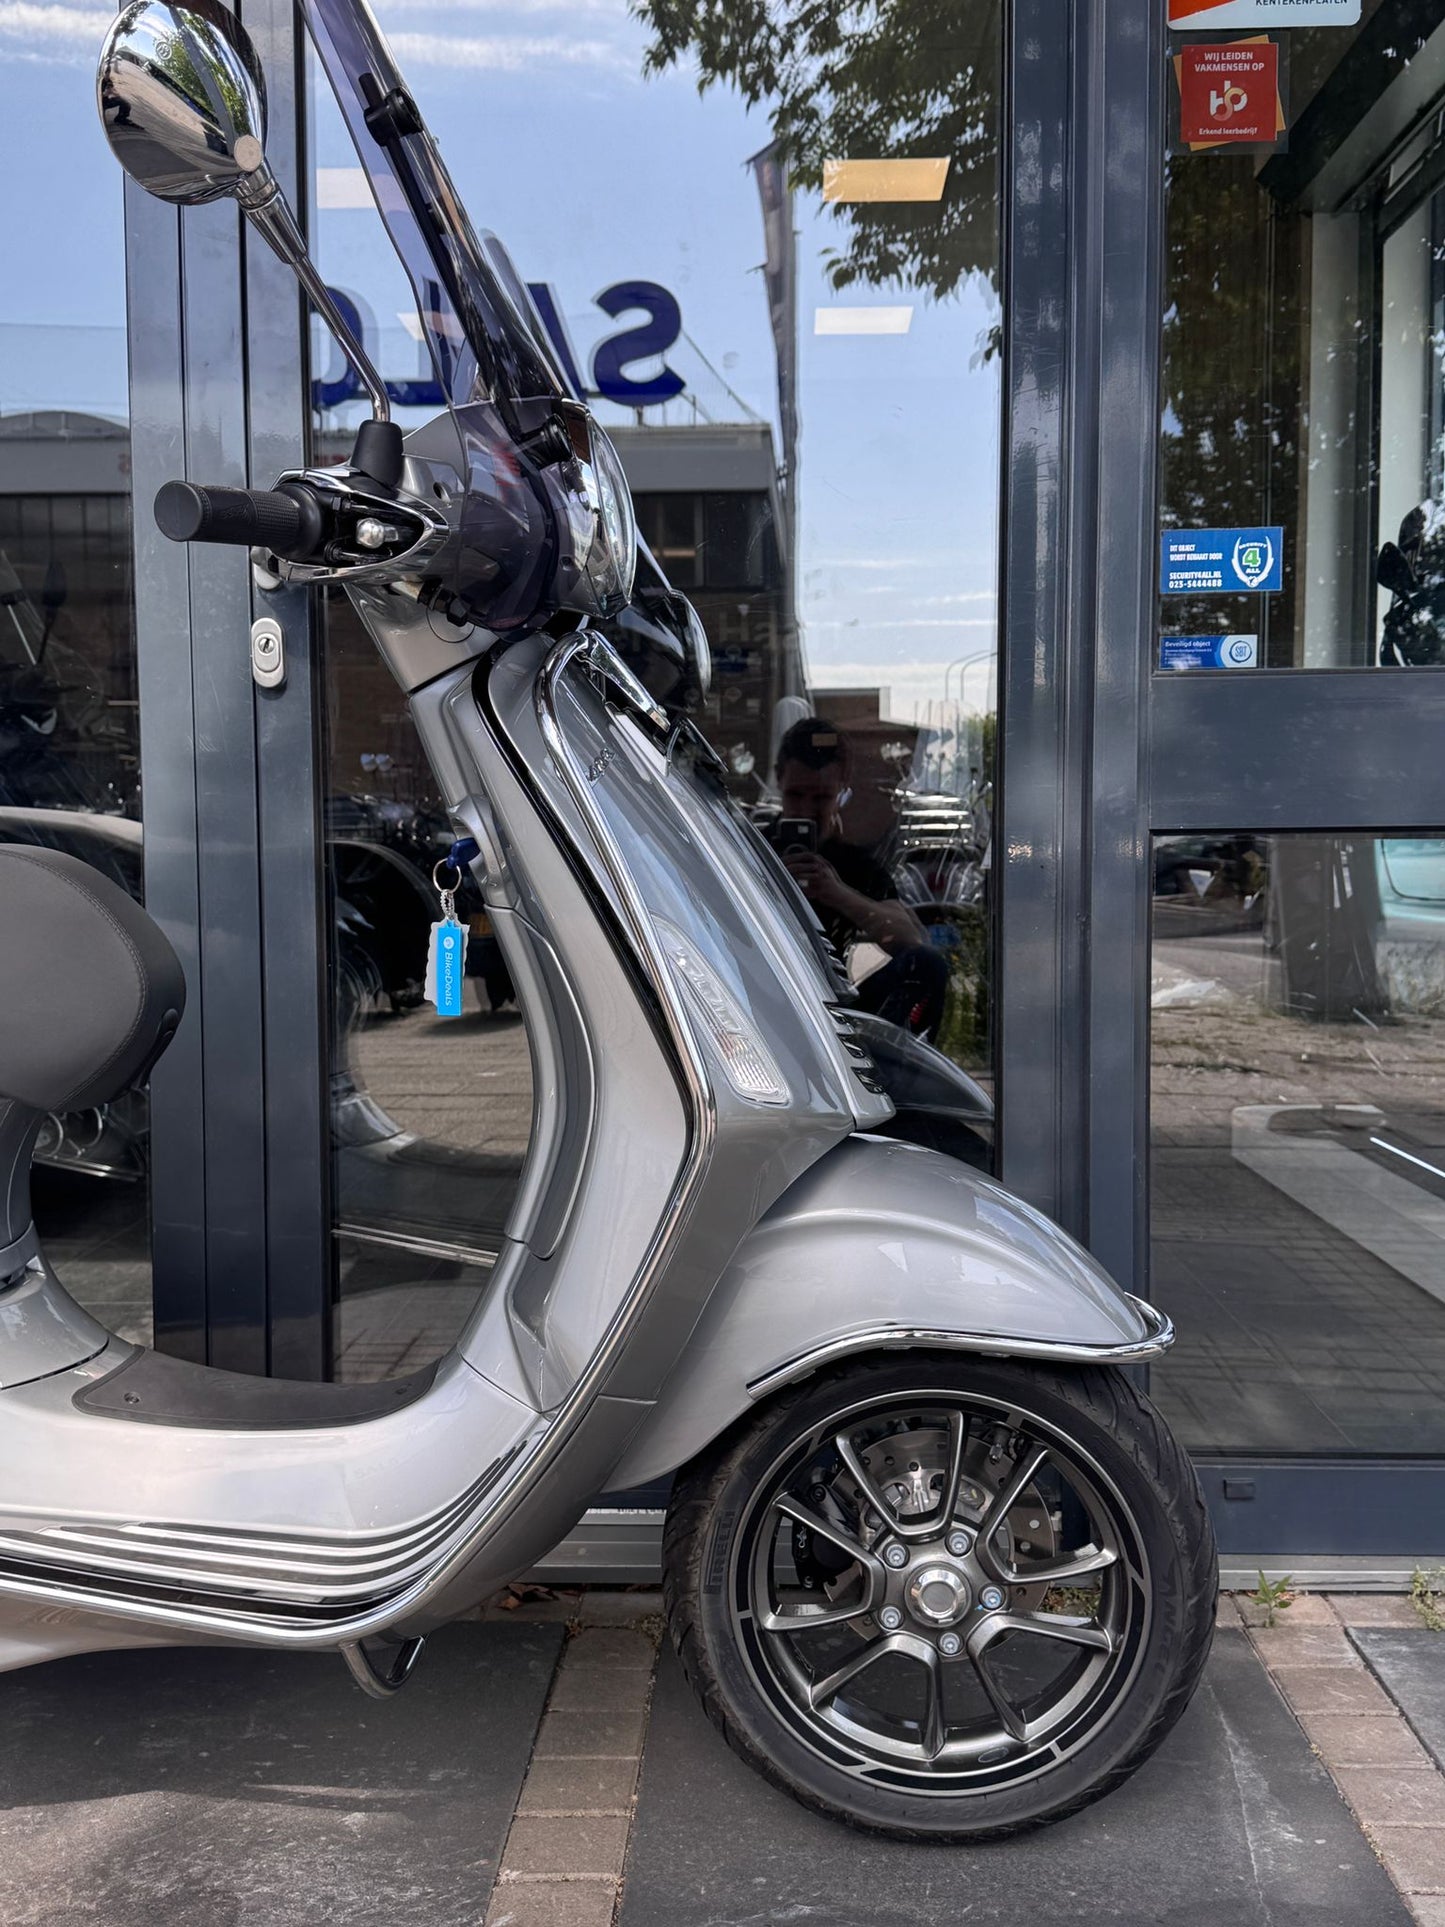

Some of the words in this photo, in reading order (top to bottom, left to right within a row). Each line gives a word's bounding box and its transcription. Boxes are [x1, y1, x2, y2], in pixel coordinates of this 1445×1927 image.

[1204, 52, 1220, 62] WIJ
[1221, 51, 1253, 60] LEIDEN
[1194, 63, 1250, 72] VAKMENSEN
[1252, 63, 1265, 71] OP
[1223, 127, 1258, 136] leerbedrijf
[1242, 548, 1261, 567] 4
[445, 952, 453, 1006] BikeDeals
